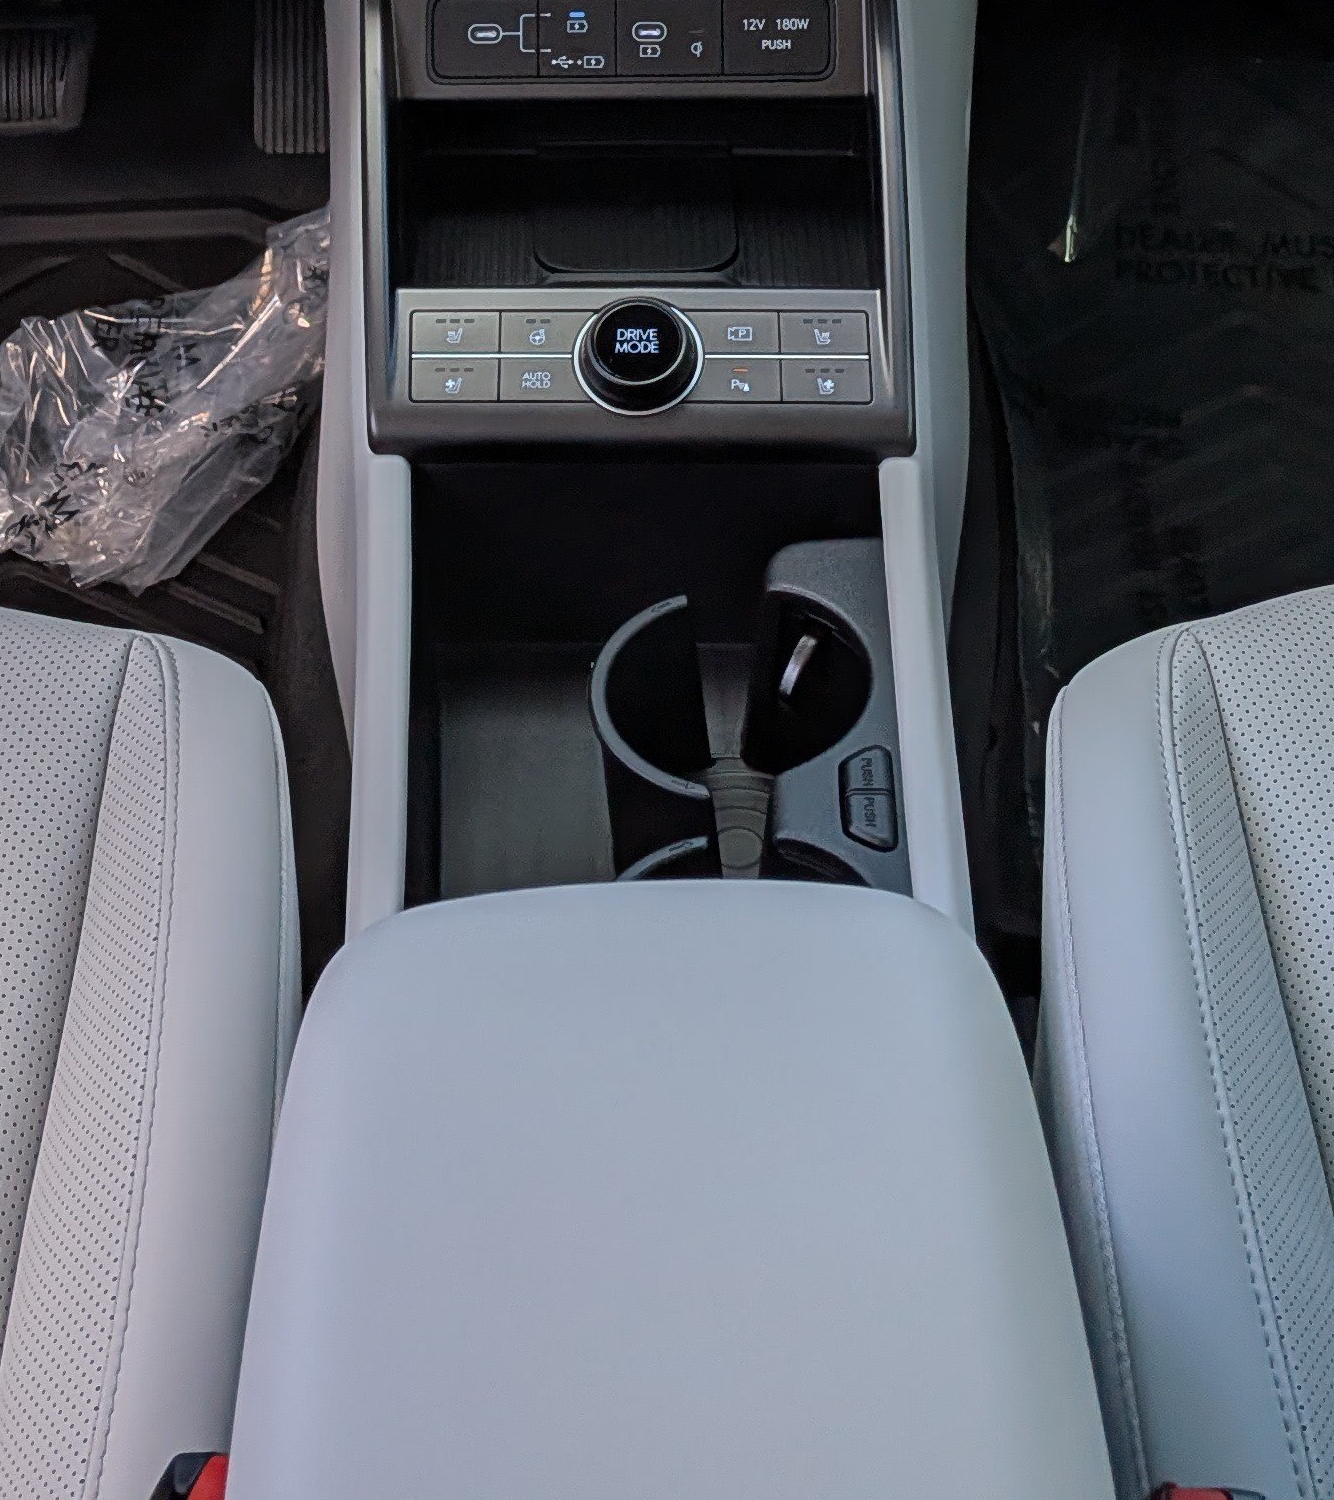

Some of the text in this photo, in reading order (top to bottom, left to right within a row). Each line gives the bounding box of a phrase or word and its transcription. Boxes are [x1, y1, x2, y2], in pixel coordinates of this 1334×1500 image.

[742, 17, 809, 31] 12V 180W
[761, 39, 791, 51] PUSH
[616, 328, 658, 341] DRIVE
[614, 341, 659, 354] MODE
[521, 371, 551, 381] AUTO
[521, 380, 551, 390] HOLD
[860, 758, 874, 787] PUSH
[864, 796, 878, 828] PUSH
